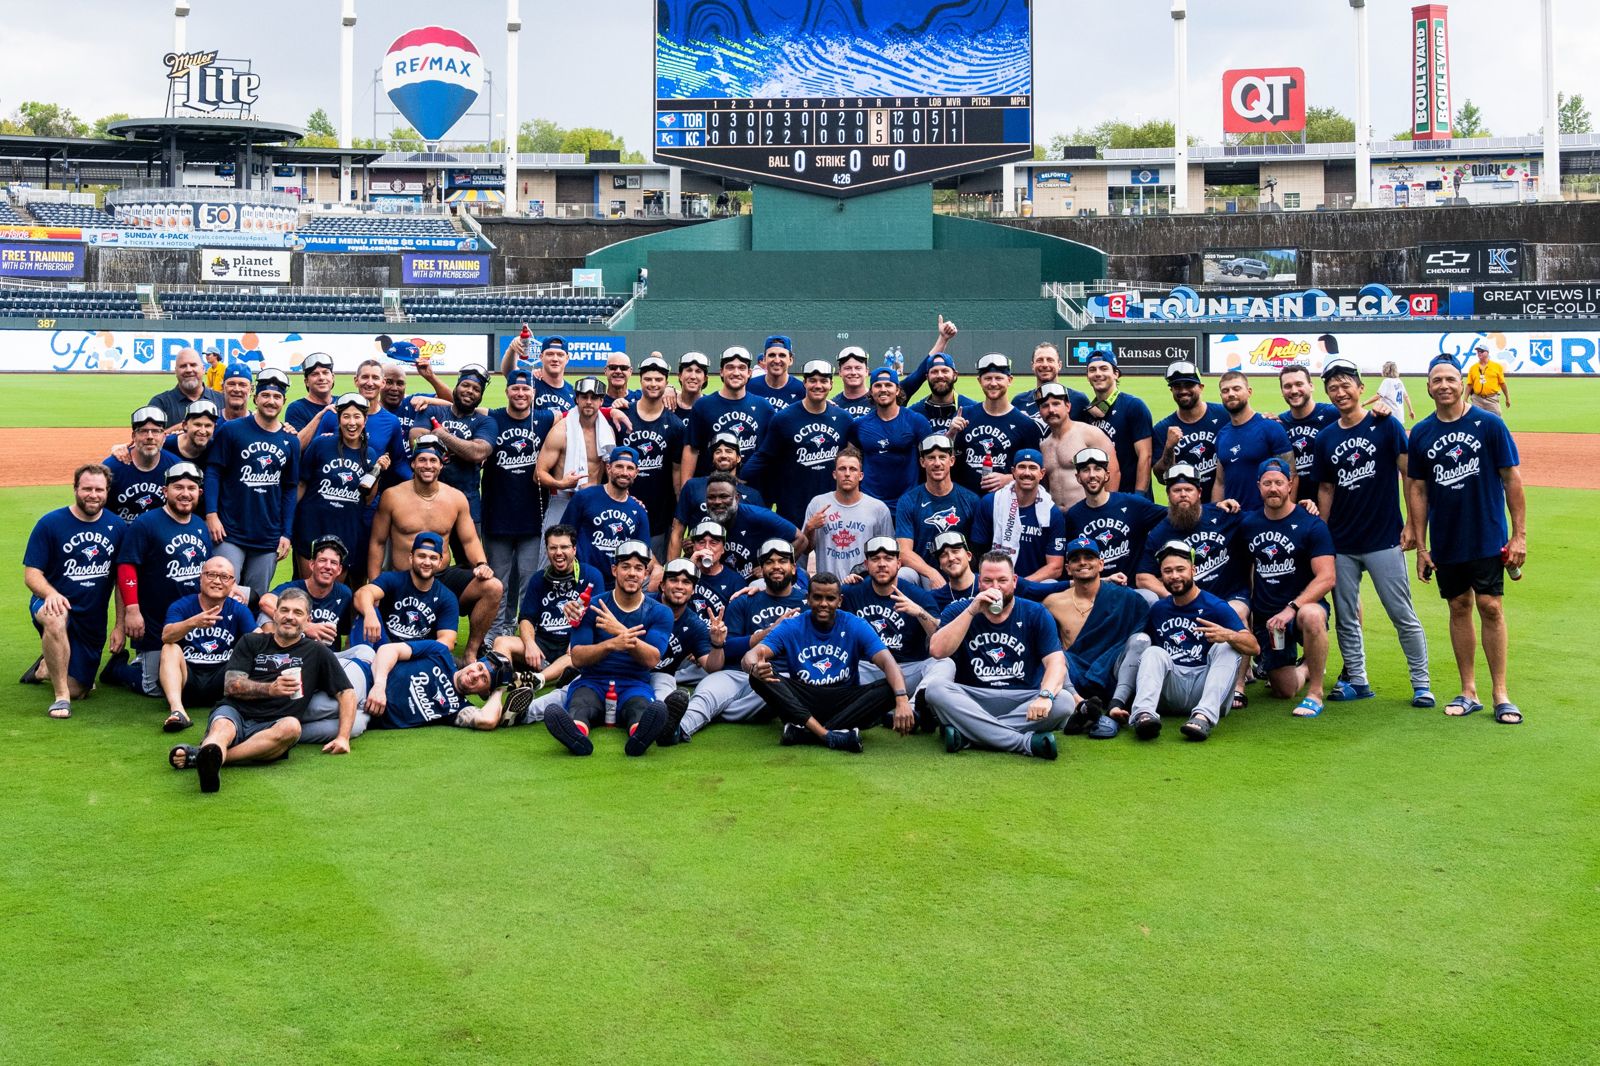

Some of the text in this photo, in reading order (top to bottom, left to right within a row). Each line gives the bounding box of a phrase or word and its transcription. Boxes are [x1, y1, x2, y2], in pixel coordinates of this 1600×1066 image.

[164, 52, 216, 76] Miller
[396, 56, 471, 77] RE/MAX
[1416, 28, 1428, 122] BOULEVARD
[1436, 27, 1448, 122] BOULEVARD
[183, 66, 260, 111] Lite
[929, 98, 942, 106] LOB
[946, 98, 961, 106] MVR
[972, 98, 990, 106] PITCH
[1011, 97, 1026, 106] MPH
[1231, 76, 1290, 121] QT
[682, 110, 956, 127] TOR 0 3 0 0 3 0 0 2 0 8 12 0 5 1
[661, 134, 673, 144] KC
[686, 128, 956, 145] KC 0 0 0 2 2 1 0 0 0 5 10 0 7 1
[768, 150, 905, 172] BALL 0 STRIKE 0 OUT 0
[833, 174, 850, 184] 4:26
[2, 250, 74, 262] FREE TRAINING
[233, 256, 273, 267] planet
[413, 260, 480, 270] FREE TRAINING
[1488, 248, 1517, 273] KC
[34, 262, 74, 270] MEMBERSHIP
[238, 267, 280, 277] fitness
[1412, 297, 1432, 312] QT
[1484, 290, 1531, 301] GREAT
[1536, 289, 1583, 300] VIEWS
[1111, 297, 1123, 314] QT
[1144, 295, 1402, 319] FOUNTAIN DECK
[1523, 303, 1596, 314] ICE-COLD
[37, 319, 55, 328] 387
[135, 338, 154, 358] KC
[568, 343, 611, 351] OFFICIAL
[569, 352, 594, 360] RAFT
[1118, 347, 1189, 360] Kansas City
[1249, 338, 1311, 364] Andy's
[1531, 342, 1552, 361] KC
[536, 394, 571, 410] OCTOBE
[442, 420, 472, 440] CTOBER
[713, 411, 758, 432] OCTOBER
[496, 428, 540, 446] OCTOBER
[623, 430, 666, 450] OCTOBER
[794, 425, 840, 443] OCTOBER
[965, 424, 1012, 449] OCTOBER
[241, 442, 287, 466] OCTOBER
[1331, 437, 1376, 464] OCTOBER
[1427, 432, 1482, 459] OCTOBER
[322, 458, 364, 479] OCTOBE
[638, 455, 663, 467] seball
[1433, 458, 1480, 482] Baseball
[240, 465, 280, 484] Baseball
[593, 509, 635, 534] OCTOBER
[829, 512, 841, 522] OK
[1004, 498, 1018, 542] BODYARMOR
[823, 520, 866, 534] BLUE JAYS
[1026, 525, 1042, 536] JAYS
[1079, 518, 1130, 538] OCTOBER
[63, 532, 114, 556] OCTOBER
[1184, 532, 1226, 545] TOBER
[1249, 532, 1295, 554] OCTOBER
[826, 548, 860, 559] TORONTO
[1100, 540, 1129, 558] seball
[64, 560, 110, 578] Baseball
[1195, 548, 1229, 575] aseball
[1256, 557, 1296, 575] Baseball
[394, 597, 436, 624] OCTOBER
[857, 605, 904, 630] OCTOBER
[185, 627, 234, 646] OCTOBER
[969, 633, 1025, 656] OCTOBER
[798, 645, 849, 664] OCTOBER
[971, 658, 1025, 678] Baseball
